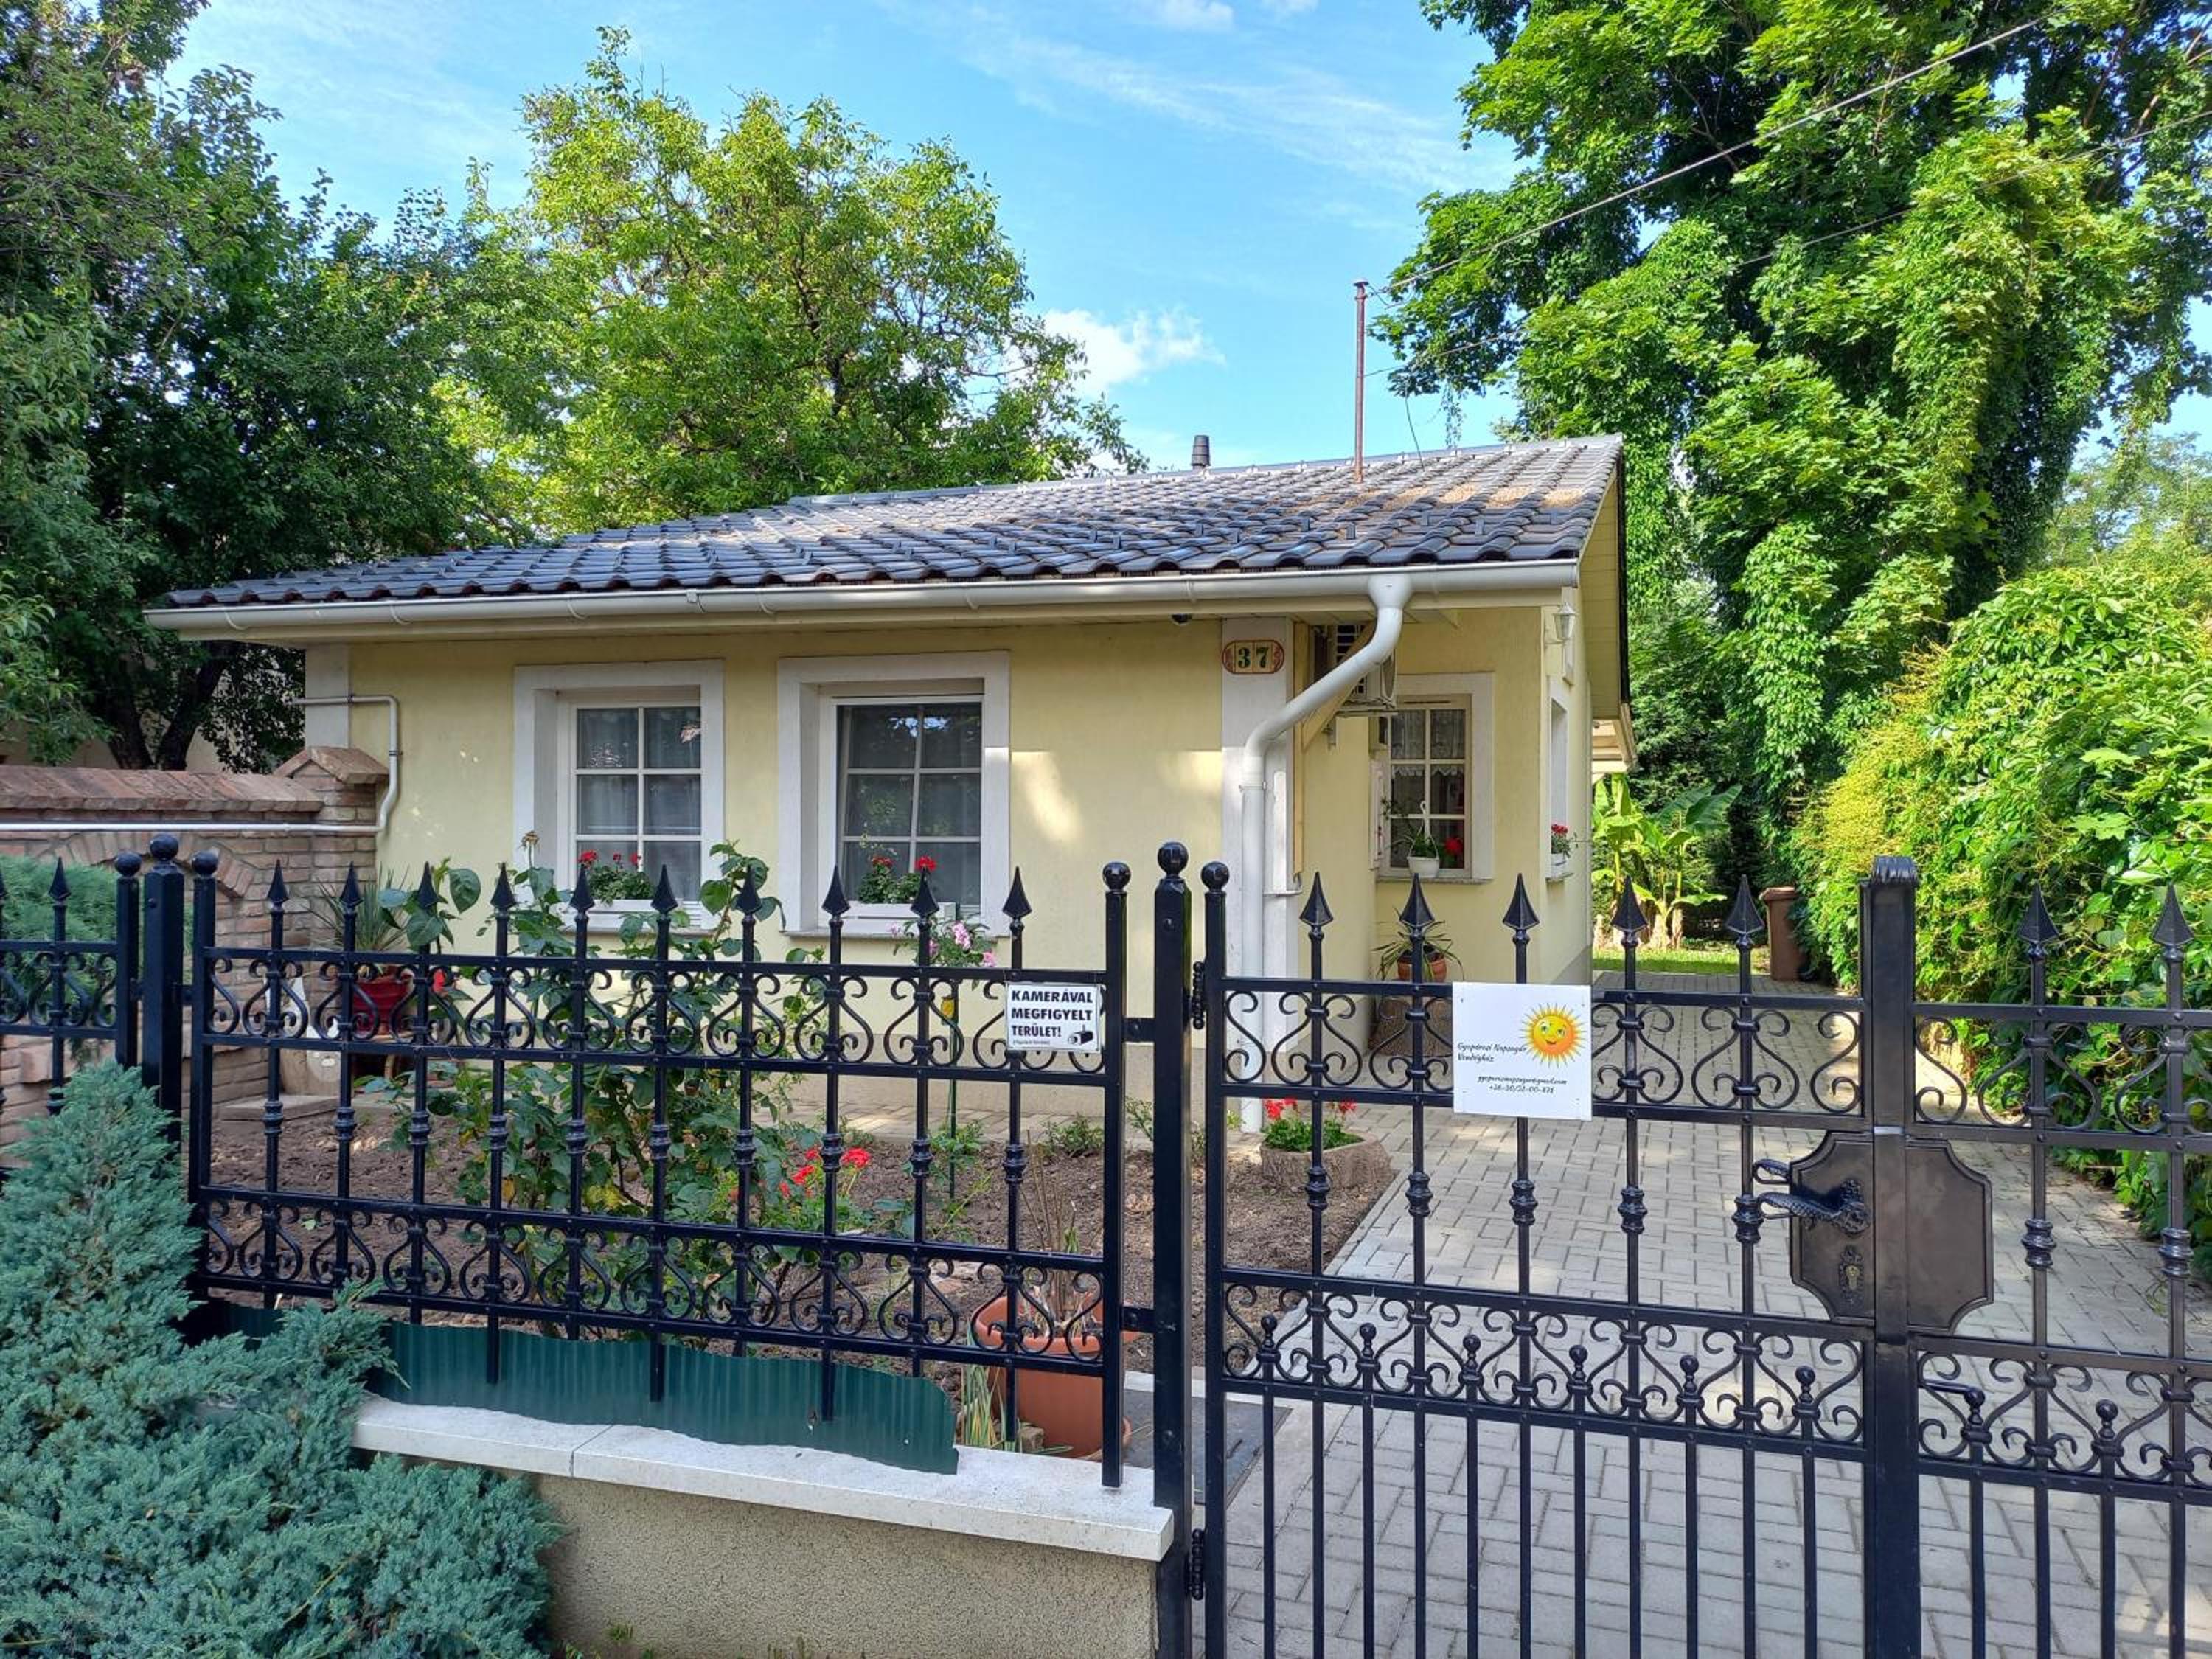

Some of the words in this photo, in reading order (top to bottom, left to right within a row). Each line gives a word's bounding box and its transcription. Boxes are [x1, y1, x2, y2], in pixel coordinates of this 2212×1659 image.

[1238, 647, 1270, 669] 37
[1012, 988, 1093, 1004] KAMERÁVAL
[1011, 1007, 1093, 1021] MEGFIGYELT
[1011, 1023, 1062, 1038] TERÜLET!
